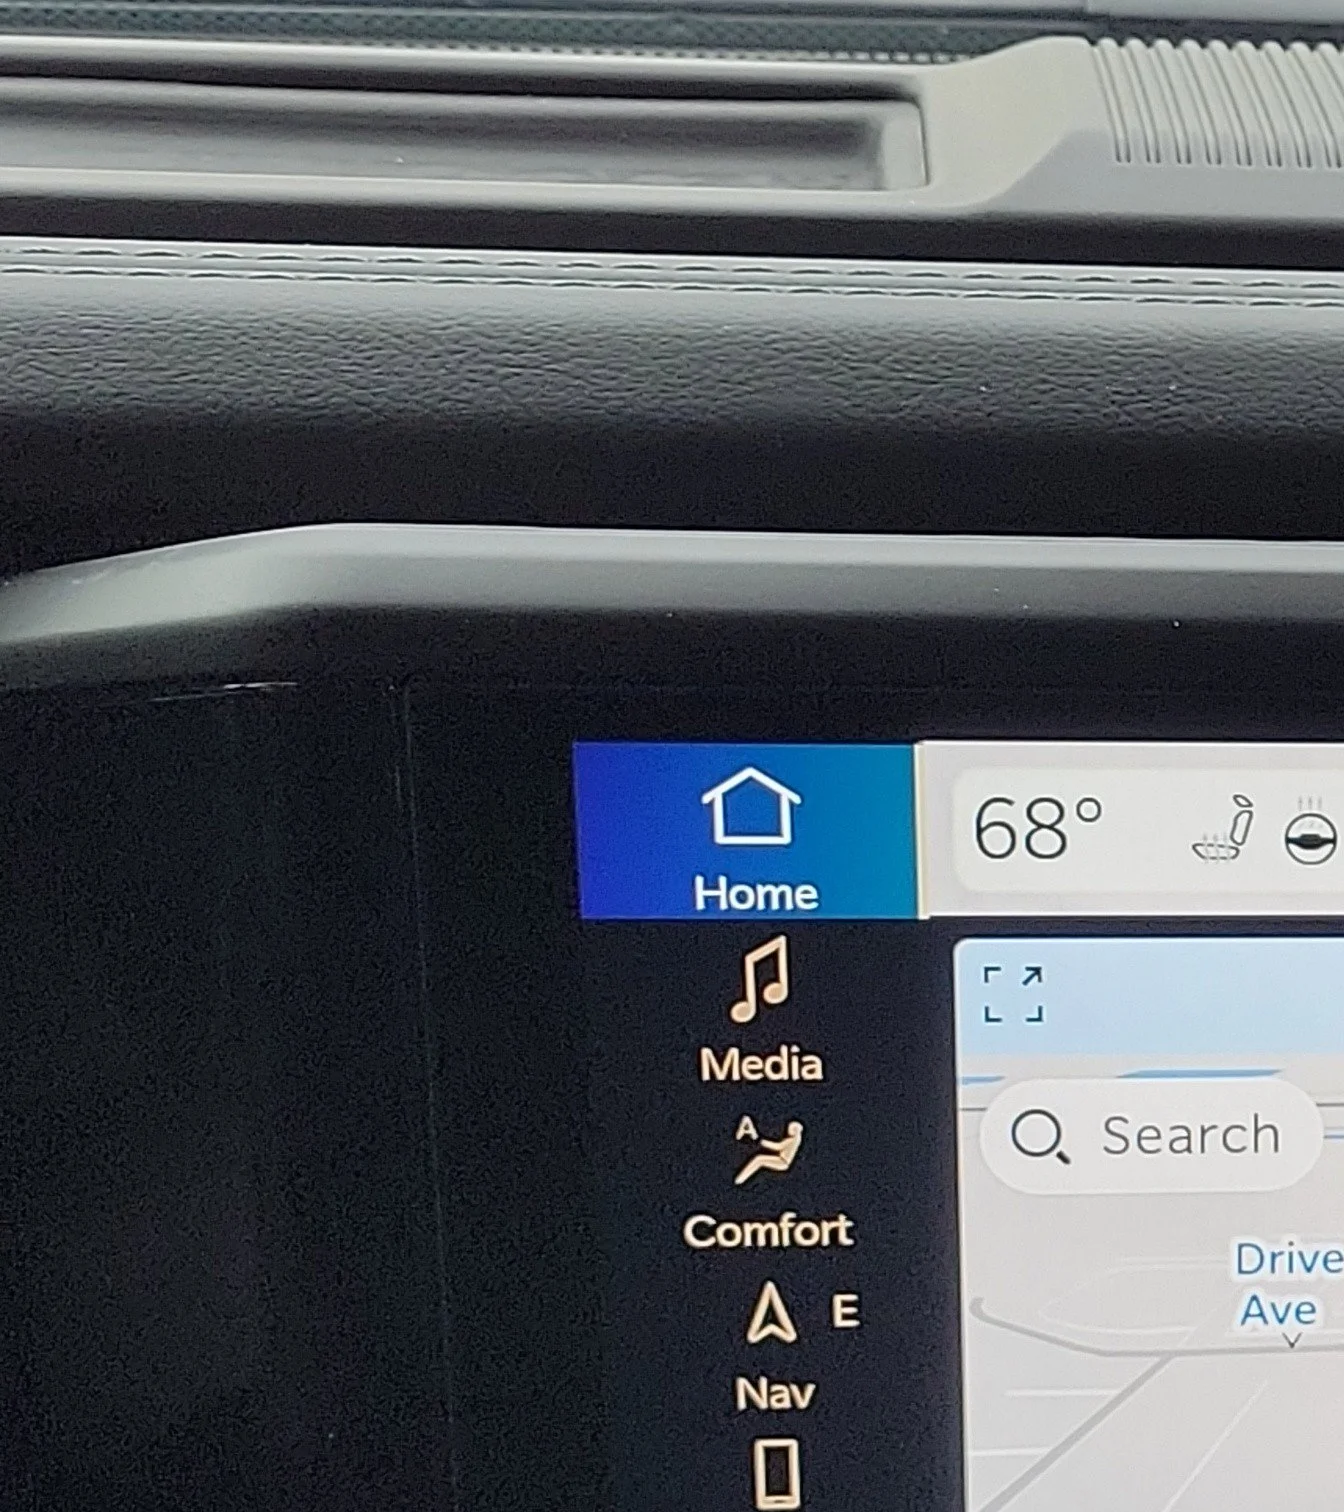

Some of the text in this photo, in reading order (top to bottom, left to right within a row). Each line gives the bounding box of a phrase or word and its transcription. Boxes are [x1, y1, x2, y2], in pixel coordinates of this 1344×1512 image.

[693, 876, 819, 912] Home
[699, 1047, 823, 1083] Media
[1102, 1113, 1282, 1156] Search
[682, 1213, 854, 1249] Comfort
[832, 1294, 859, 1327] E
[1240, 1294, 1318, 1328] Ave
[735, 1378, 816, 1410] Nav
